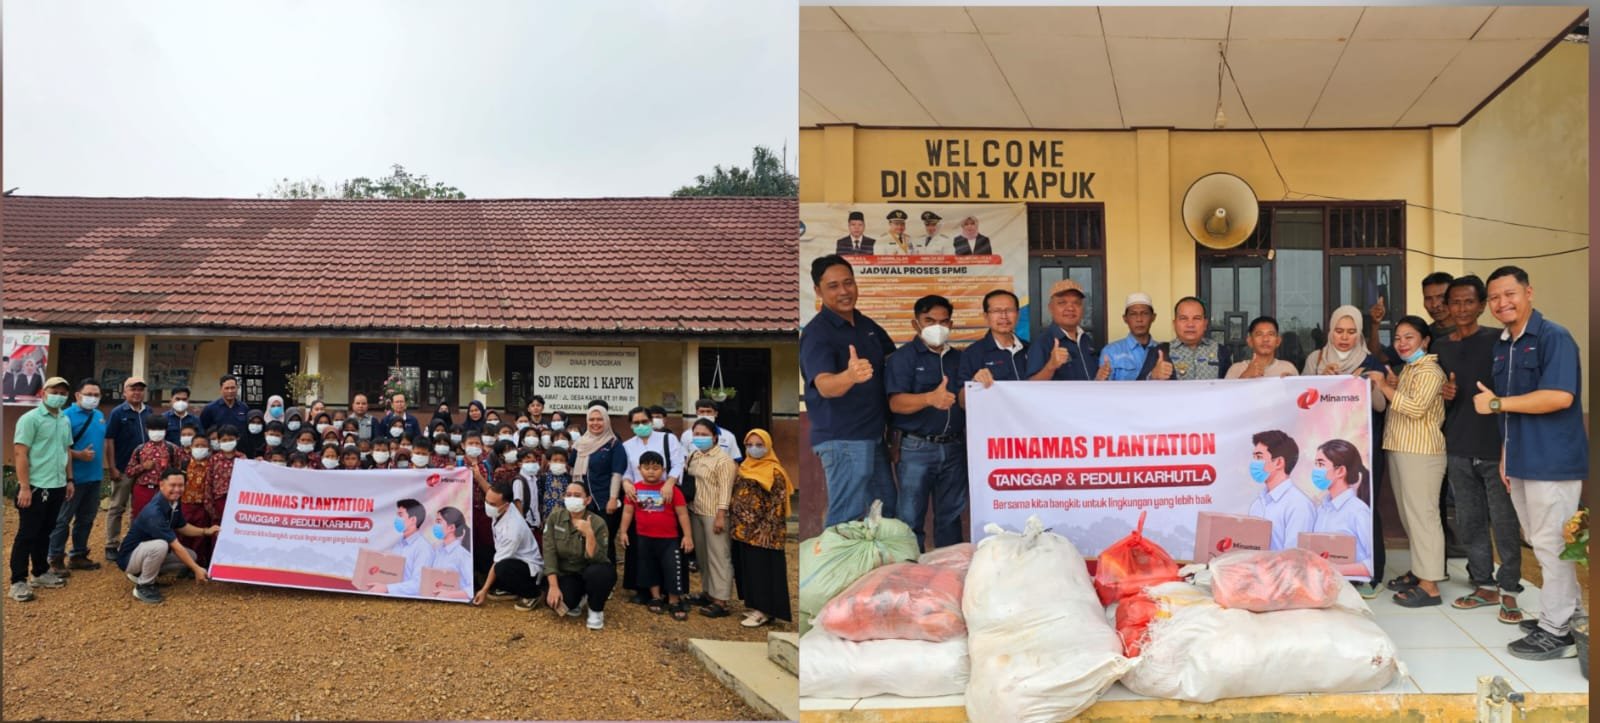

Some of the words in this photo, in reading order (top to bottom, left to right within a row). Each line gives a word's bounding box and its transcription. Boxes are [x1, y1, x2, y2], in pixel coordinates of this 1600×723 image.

[925, 139, 1064, 168] WELCOME
[881, 170, 907, 198] DI
[914, 170, 970, 199] SDN
[976, 171, 990, 199] 1
[1003, 171, 1096, 199] KAPUK
[860, 266, 902, 275] JADWAL
[903, 266, 940, 275] PROSES
[538, 375, 551, 388] SD
[553, 375, 590, 389] NEGERI
[593, 376, 599, 389] 1
[601, 376, 635, 390] KAPUK
[1319, 393, 1361, 403] Minamas
[987, 436, 1089, 460] MINAMAS
[1092, 432, 1217, 458] PLANTATION
[992, 473, 1062, 488] TANGGAP
[1065, 472, 1077, 486] &
[1080, 471, 1131, 486] PEDULI
[1133, 469, 1213, 485] KARHUTLA
[238, 491, 299, 510] MINAMAS
[300, 495, 375, 513] PLANTATION
[992, 498, 1031, 510] Bersama
[1031, 498, 1049, 509] kita
[1049, 497, 1081, 511] bangkit
[1082, 496, 1107, 508] untuk
[1108, 495, 1153, 510] lingkungan
[1153, 496, 1175, 509] yang
[1175, 494, 1195, 505] lebih
[1195, 494, 1213, 505] baik
[238, 512, 280, 525] TANGGAP
[290, 517, 321, 528] PEDULI
[322, 519, 371, 530] KARHUTLA
